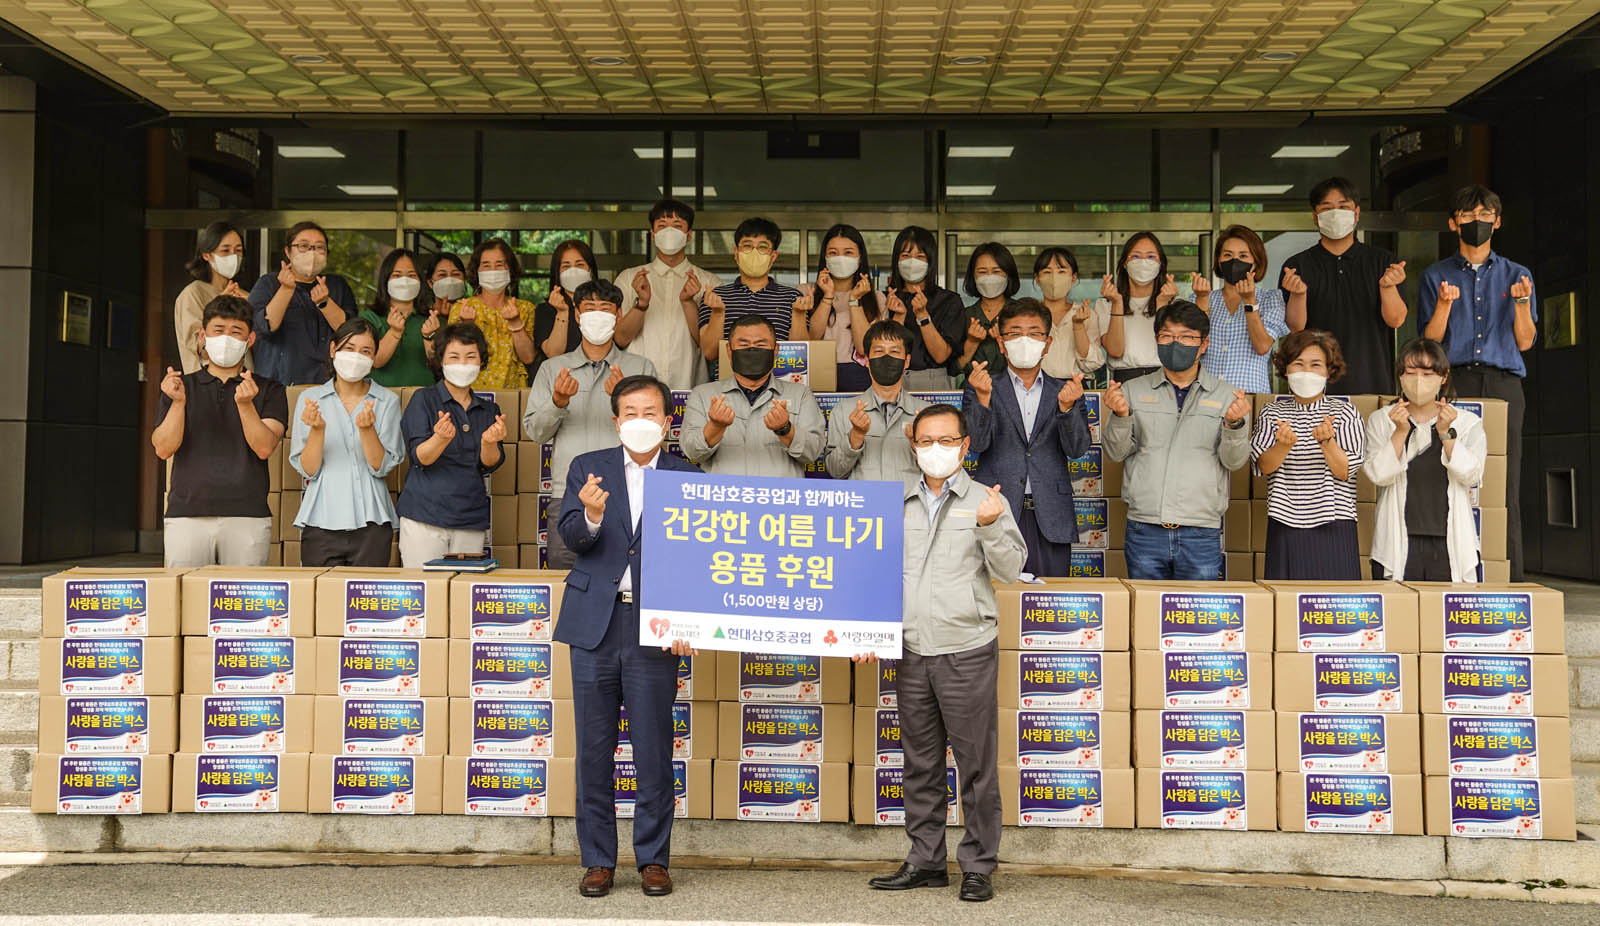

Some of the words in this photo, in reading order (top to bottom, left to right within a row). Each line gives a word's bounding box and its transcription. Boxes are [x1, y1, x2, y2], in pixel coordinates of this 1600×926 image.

[787, 357, 805, 368] 박스
[1081, 461, 1100, 473] 박스
[681, 482, 801, 506] 현대삼호중공업과
[804, 489, 865, 509] 함께하는
[1086, 514, 1105, 525] 박스
[662, 507, 751, 545] 건강한
[758, 513, 817, 548] 여름
[826, 516, 883, 551] 나기
[709, 550, 768, 587] 용품
[775, 553, 834, 590] 후원
[1083, 565, 1102, 577] 박스
[69, 597, 100, 611] 사랑을
[101, 597, 121, 611] 담은
[122, 597, 143, 610] 박스
[213, 597, 243, 611] 사랑을
[244, 598, 264, 612] 담은
[265, 599, 285, 611] 박스
[349, 597, 379, 611] 사랑을
[380, 597, 400, 611] 담은
[402, 599, 421, 611] 박스
[475, 601, 505, 615] 사랑을
[506, 601, 525, 615] 담은
[527, 602, 547, 615] 박스
[723, 592, 790, 610] (1,500만원
[792, 596, 824, 612] 상당)
[1024, 609, 1056, 623] 사랑을
[1057, 609, 1077, 624] 담은
[1079, 610, 1099, 624] 박스
[1164, 610, 1196, 625] 사랑을
[1197, 611, 1218, 625] 담은
[1219, 612, 1240, 625] 박스
[1302, 611, 1334, 625] 사랑을
[1335, 611, 1356, 625] 담은
[1358, 611, 1379, 625] 박스
[1448, 610, 1481, 625] 사랑을
[1482, 611, 1503, 625] 담은
[1505, 611, 1528, 625] 박스
[727, 626, 812, 645] 현대삼호중공업
[841, 631, 895, 644] 사랑의열매
[65, 655, 96, 669] 사랑을
[97, 655, 117, 669] 담은
[119, 655, 139, 669] 박스
[217, 655, 247, 668] 사랑을
[249, 655, 269, 668] 담은
[270, 655, 290, 668] 박스
[343, 656, 373, 670] 사랑을
[375, 657, 395, 671] 담은
[396, 658, 416, 670] 박스
[475, 658, 505, 673] 사랑을
[506, 659, 526, 673] 담은
[527, 660, 548, 673] 박스
[743, 662, 774, 676] 사랑을
[775, 663, 795, 677] 담은
[796, 663, 817, 677] 박스
[1023, 670, 1054, 684] 사랑을
[1055, 670, 1076, 684] 담은
[1077, 671, 1098, 683] 박스
[1168, 668, 1200, 683] 사랑을
[1201, 669, 1222, 682] 담은
[1223, 668, 1245, 681] 박스
[1319, 671, 1351, 685] 사랑을
[1352, 671, 1374, 685] 담은
[1375, 671, 1396, 685] 박스
[1447, 671, 1481, 687] 사랑을
[1482, 673, 1504, 687] 담은
[1505, 674, 1528, 688] 박스
[70, 714, 101, 729] 사랑을
[102, 714, 122, 728] 담은
[123, 715, 145, 728] 박스
[207, 713, 238, 728] 사랑을
[239, 713, 259, 727] 담은
[260, 713, 281, 726] 박스
[347, 716, 378, 730] 사랑을
[379, 716, 399, 730] 담은
[400, 717, 421, 730] 박스
[476, 716, 507, 730] 사랑을
[508, 717, 527, 731] 담은
[529, 717, 549, 730] 박스
[745, 720, 777, 735] 사랑을
[777, 721, 797, 736] 담은
[799, 722, 819, 736] 박스
[1021, 728, 1053, 743] 사랑을
[1054, 729, 1075, 743] 담은
[1075, 729, 1097, 743] 박스
[1165, 728, 1197, 743] 사랑을
[1198, 728, 1218, 742] 담은
[1220, 729, 1241, 742] 박스
[1303, 731, 1336, 746] 사랑을
[1337, 731, 1358, 746] 담은
[1360, 732, 1382, 746] 박스
[1453, 735, 1486, 749] 사랑을
[1487, 735, 1509, 750] 담은
[1510, 735, 1533, 749] 박스
[63, 773, 94, 788] 사랑을
[95, 774, 115, 788] 담은
[117, 774, 137, 787] 박스
[200, 771, 231, 785] 사랑을
[232, 771, 253, 785] 담은
[254, 772, 274, 785] 박스
[336, 773, 367, 788] 사랑을
[368, 774, 388, 788] 담은
[390, 774, 410, 787] 박스
[471, 775, 501, 789] 사랑을
[501, 775, 521, 789] 담은
[523, 776, 543, 789] 박스
[742, 780, 773, 794] 사랑을
[774, 781, 794, 795] 담은
[795, 782, 817, 795] 박스
[880, 784, 904, 798] 사랑
[1023, 786, 1054, 800] 사랑을
[1055, 786, 1076, 800] 담은
[1077, 787, 1098, 800] 박스
[1165, 788, 1197, 803] 사랑을
[1198, 789, 1219, 803] 담은
[1220, 789, 1241, 802] 박스
[1309, 791, 1342, 806] 사랑을
[1343, 792, 1364, 806] 담은
[1366, 792, 1388, 806] 박스
[1455, 795, 1489, 810] 사랑을
[1490, 796, 1513, 811] 담은
[1514, 797, 1537, 811] 박스
